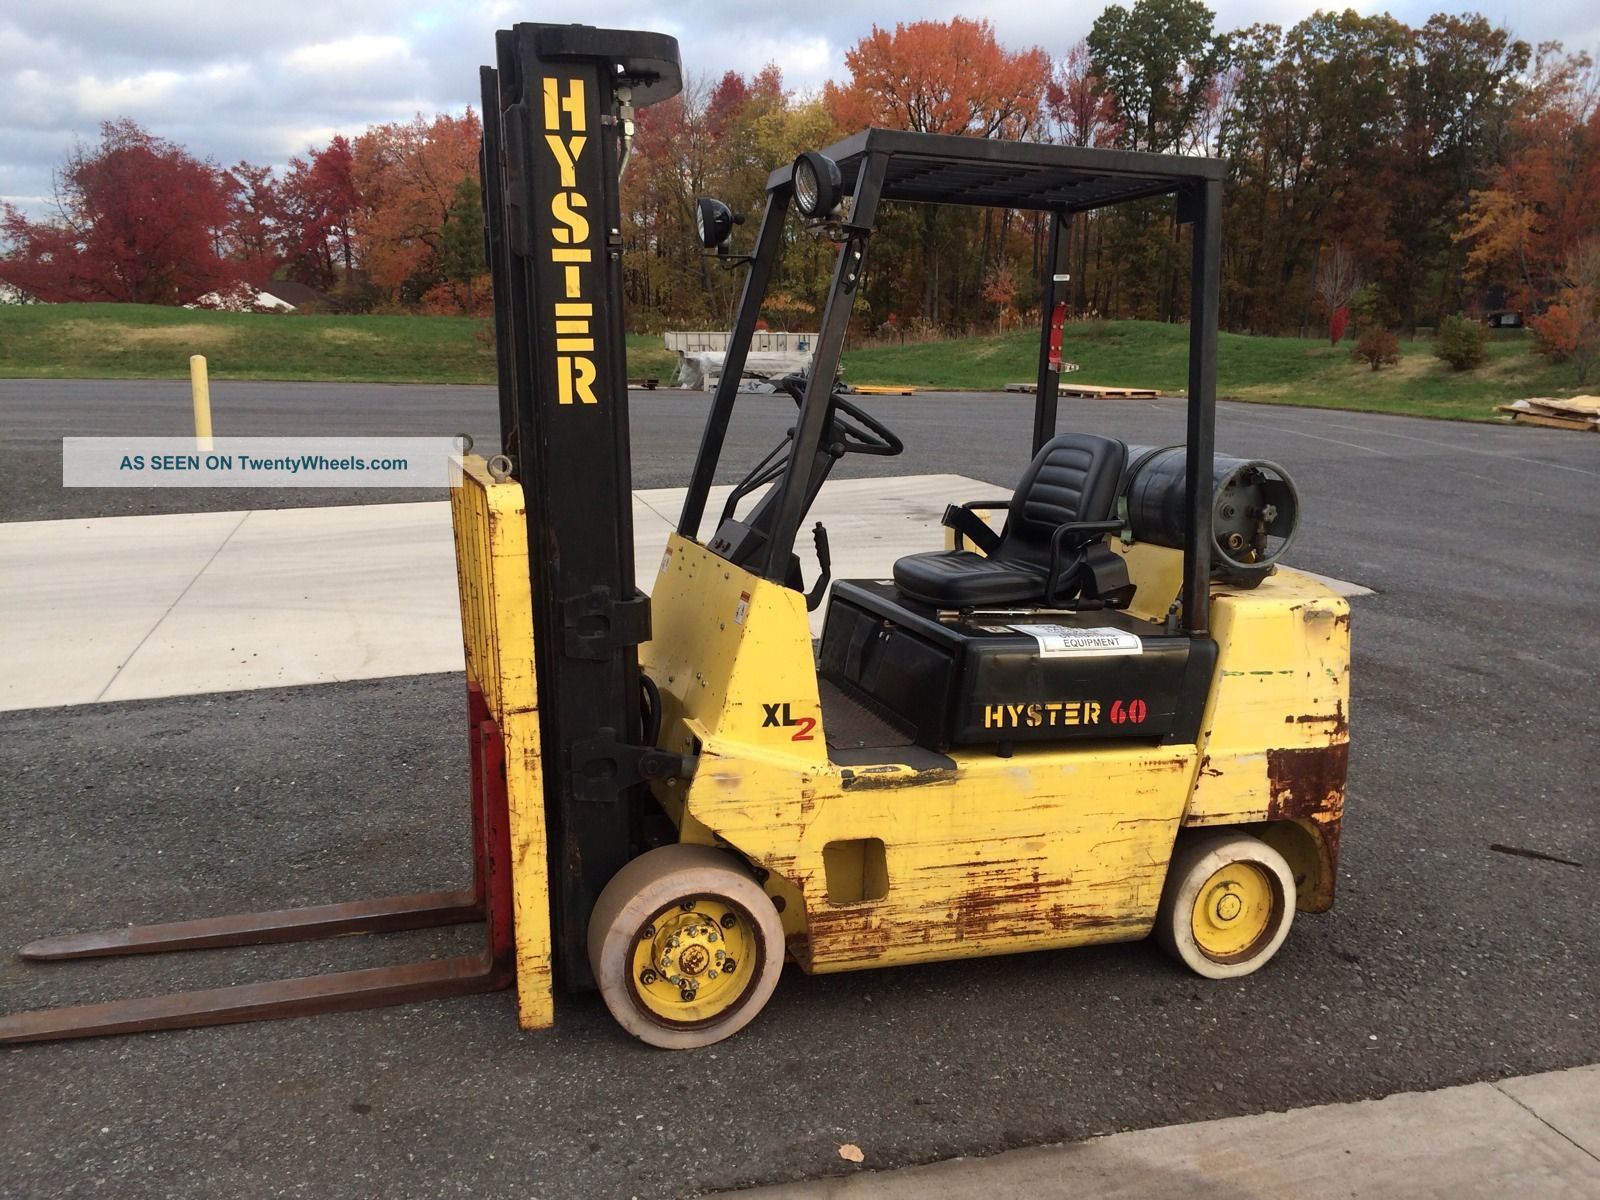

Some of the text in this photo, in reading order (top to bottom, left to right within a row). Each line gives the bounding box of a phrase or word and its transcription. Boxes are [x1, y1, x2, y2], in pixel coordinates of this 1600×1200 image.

[543, 77, 598, 404] HYSTER
[1064, 637, 1120, 648] EQUIPMENT
[984, 699, 1147, 729] HYSTER 60
